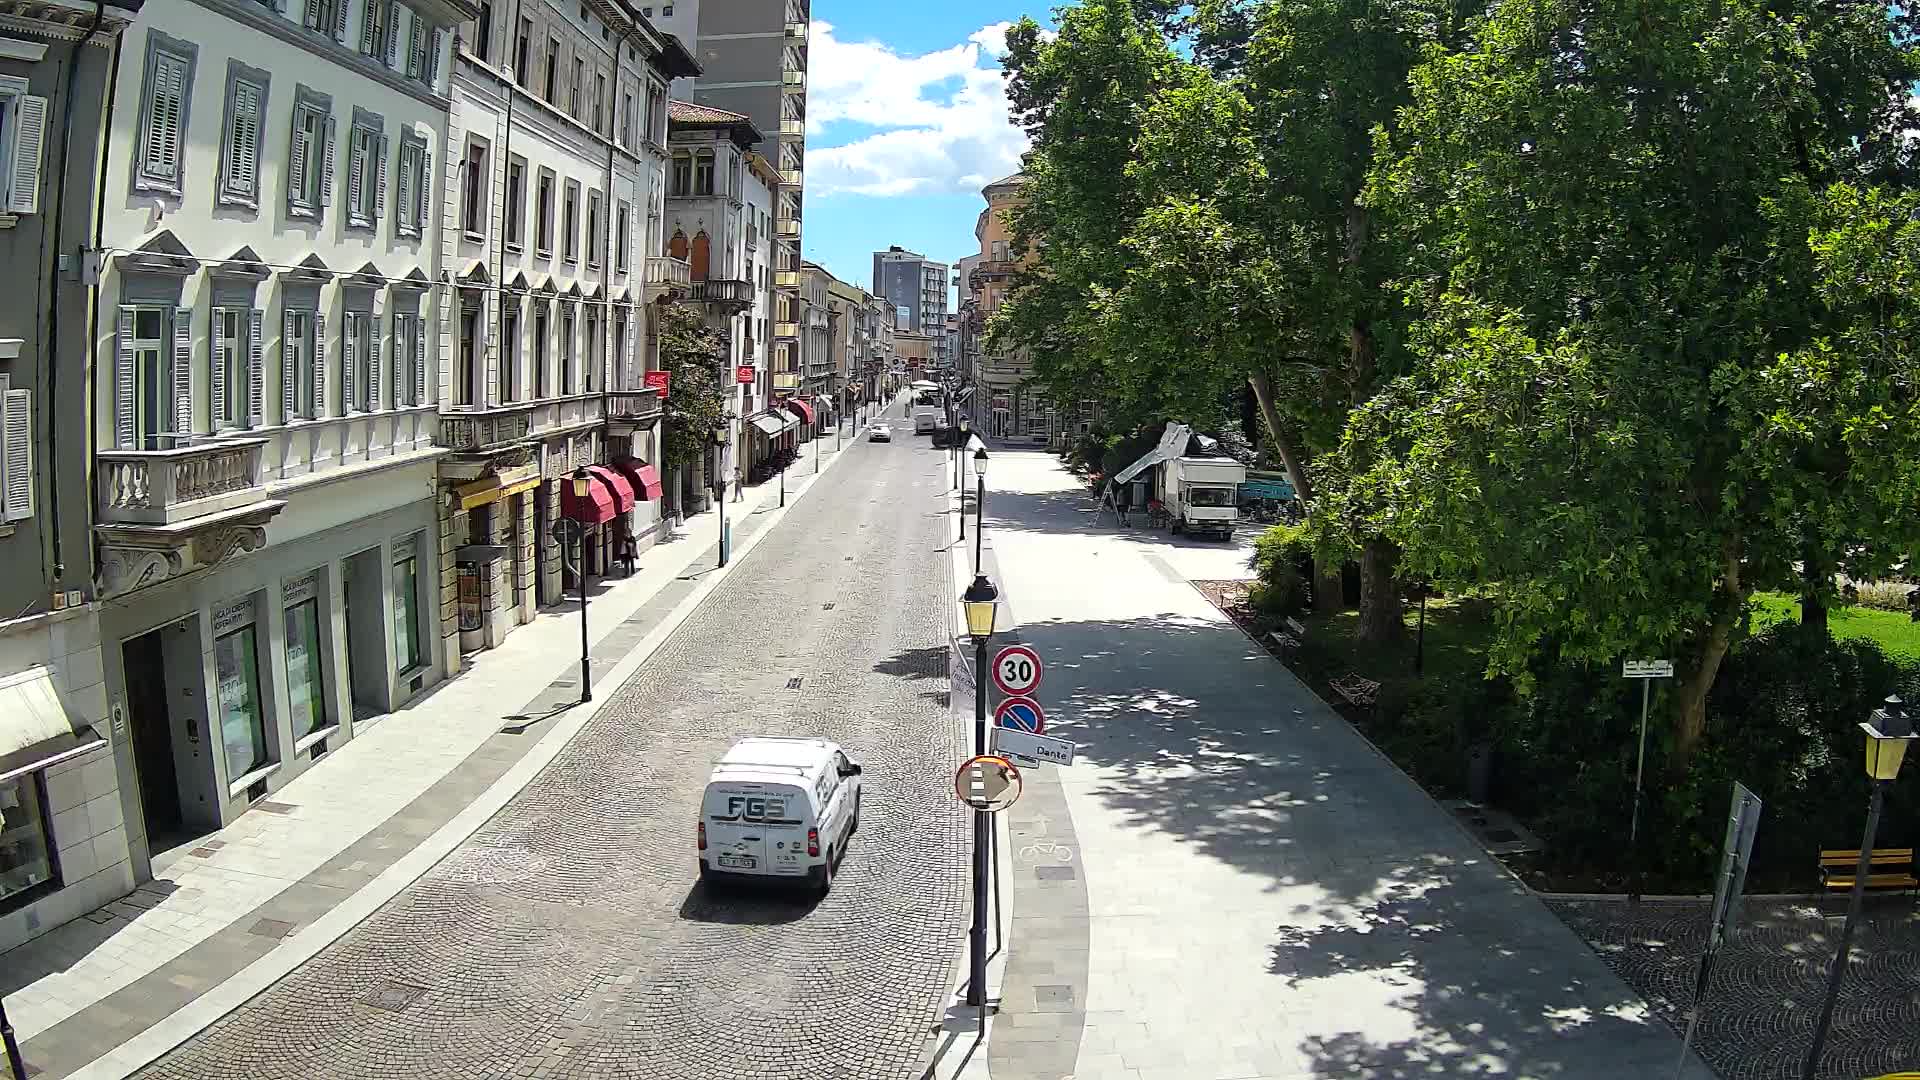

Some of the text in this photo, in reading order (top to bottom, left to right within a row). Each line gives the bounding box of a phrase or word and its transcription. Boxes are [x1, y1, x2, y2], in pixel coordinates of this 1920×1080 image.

[1004, 660, 1032, 682] 30
[1037, 746, 1067, 760] Dante
[729, 797, 785, 817] FGS
